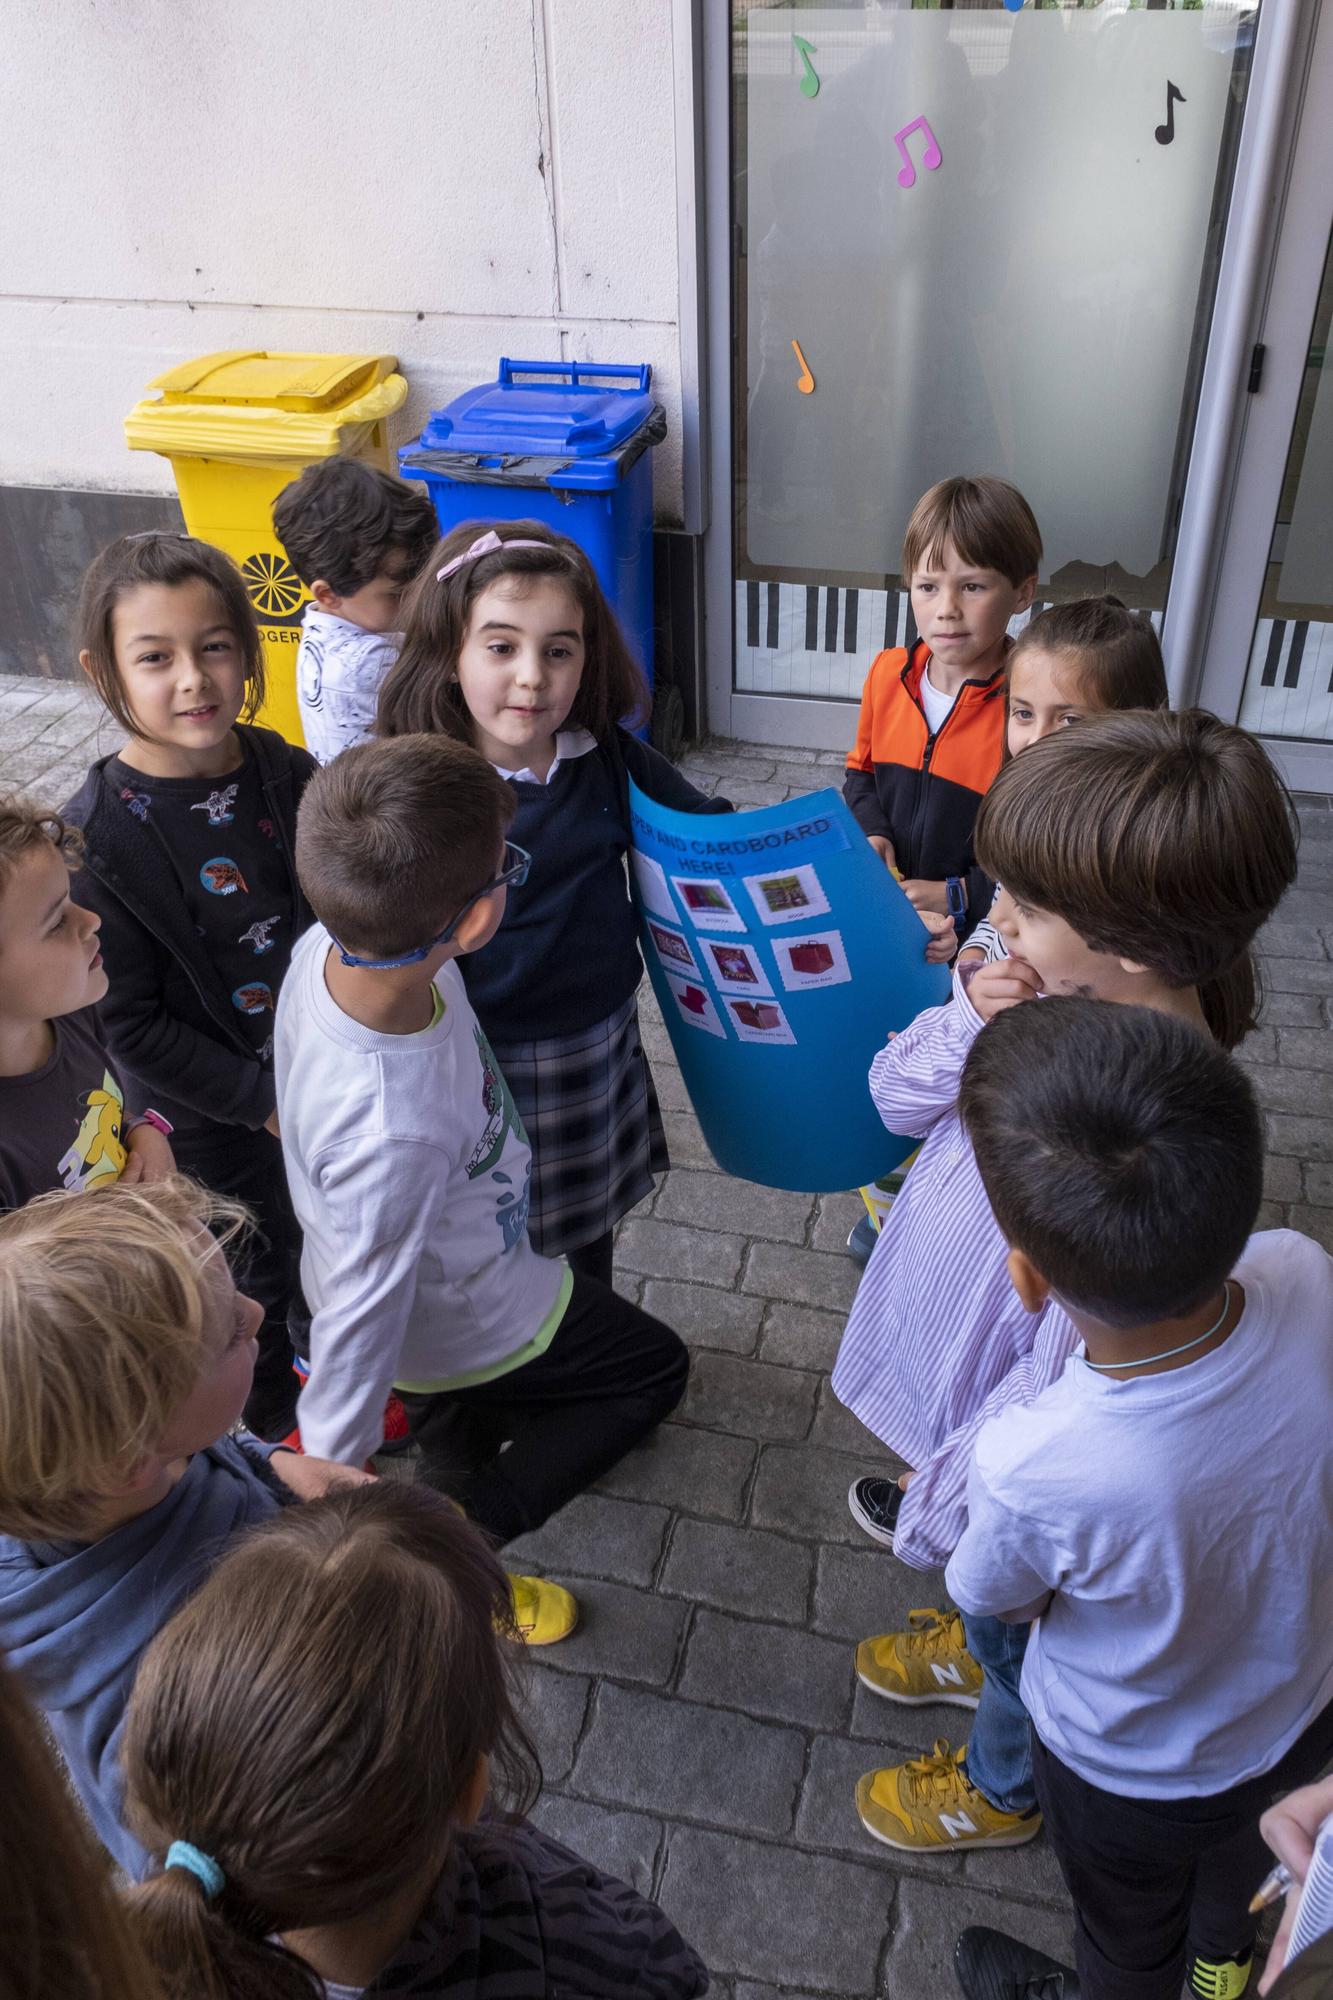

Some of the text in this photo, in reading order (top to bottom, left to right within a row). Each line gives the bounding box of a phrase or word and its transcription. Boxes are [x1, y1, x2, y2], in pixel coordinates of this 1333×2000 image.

[657, 831, 688, 852] AND
[690, 818, 832, 856] CARDBOARD
[678, 858, 735, 875] HERE!
[930, 1663, 965, 1686] N
[938, 1811, 978, 1839] N
